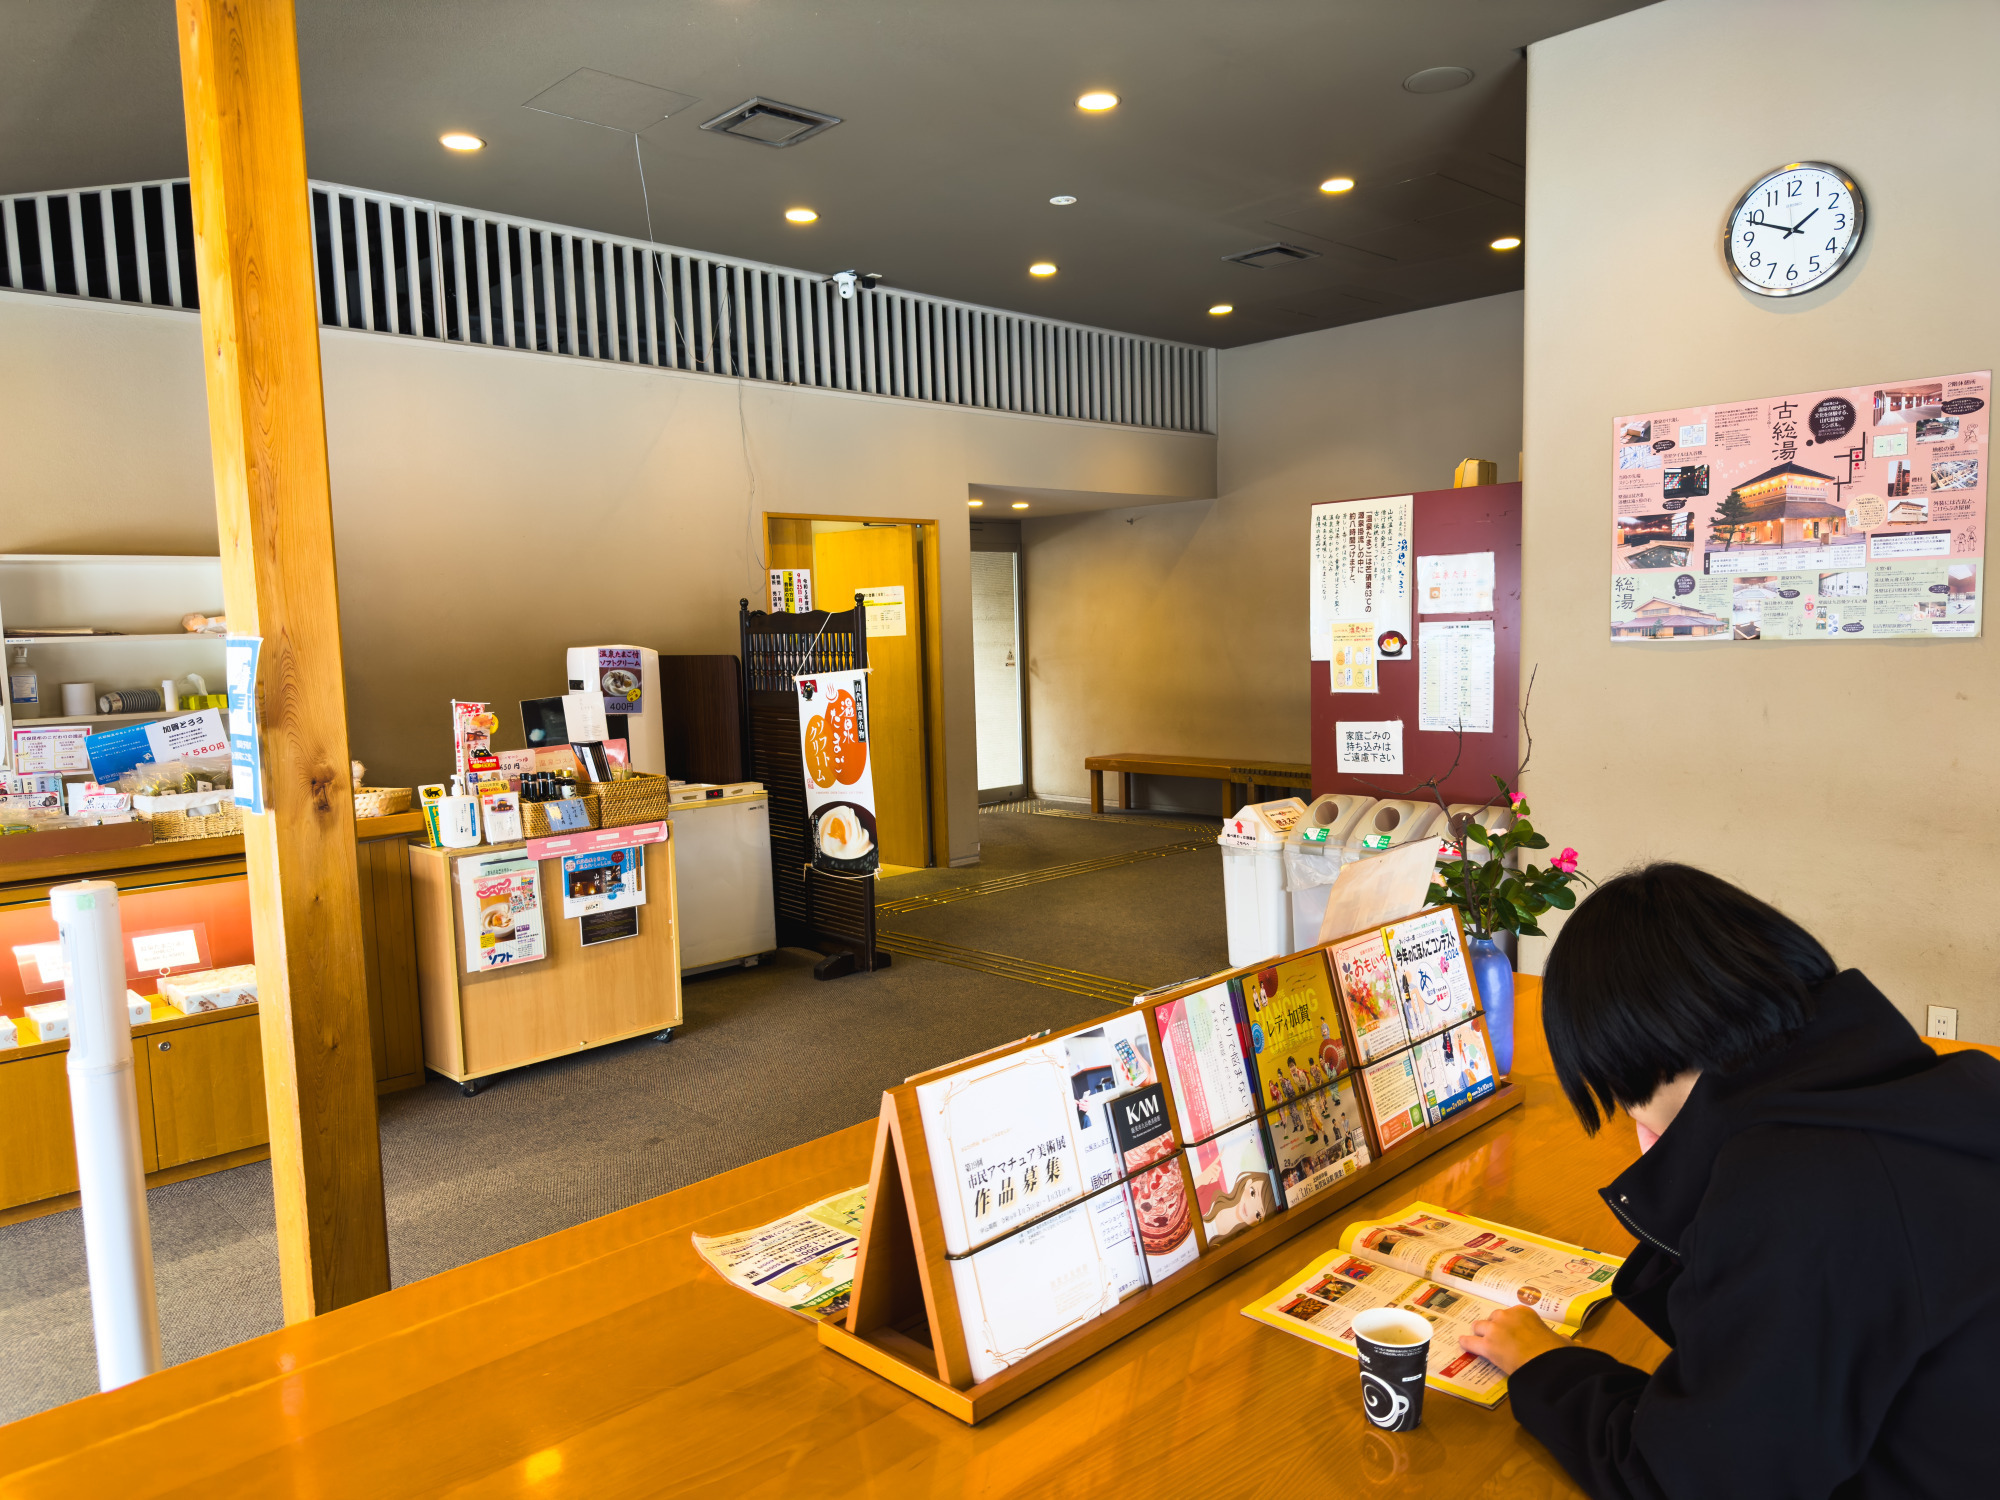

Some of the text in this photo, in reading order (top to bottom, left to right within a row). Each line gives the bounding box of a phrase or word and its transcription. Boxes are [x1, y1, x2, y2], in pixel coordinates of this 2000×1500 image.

[1787, 180, 1802, 197] 12
[1815, 181, 1820, 197] 1
[1767, 190, 1778, 207] 11
[1828, 192, 1840, 209] 2
[1749, 209, 1764, 226] 10
[1834, 213, 1846, 230] 3
[1743, 231, 1755, 248] 9
[1825, 237, 1838, 253] 4
[1749, 251, 1761, 267] 8
[1809, 255, 1820, 272] 5
[1767, 262, 1777, 279] 7
[1786, 264, 1798, 280] 6
[1772, 401, 1798, 461] 古総湯
[1357, 511, 1365, 574] 源泉掛流しの中に
[1615, 576, 1635, 610] 総湯
[599, 649, 640, 659] 温泉たまご付
[600, 659, 641, 667] ソフトクリーム
[610, 703, 634, 711] 400円
[853, 682, 866, 741] 山代温泉名物
[162, 716, 204, 734] 加賀とろろ
[817, 720, 831, 767] ソフト
[1346, 730, 1391, 741] 家庭ごみの
[193, 741, 225, 756] 580円
[810, 726, 826, 782] クリーム
[1346, 742, 1392, 752] 持ち込みは
[1343, 752, 1396, 763] ご遠慮下さい
[488, 952, 513, 965] ソフト
[1444, 949, 1461, 962] 2024
[1417, 967, 1434, 992] あ
[1266, 1004, 1312, 1037] レディ加賀
[1125, 1094, 1160, 1126] KAM
[964, 1157, 984, 1173] 第19回
[967, 1135, 1067, 1190] 市民アマチュア美術展
[974, 1155, 1061, 1219] 作品募集
